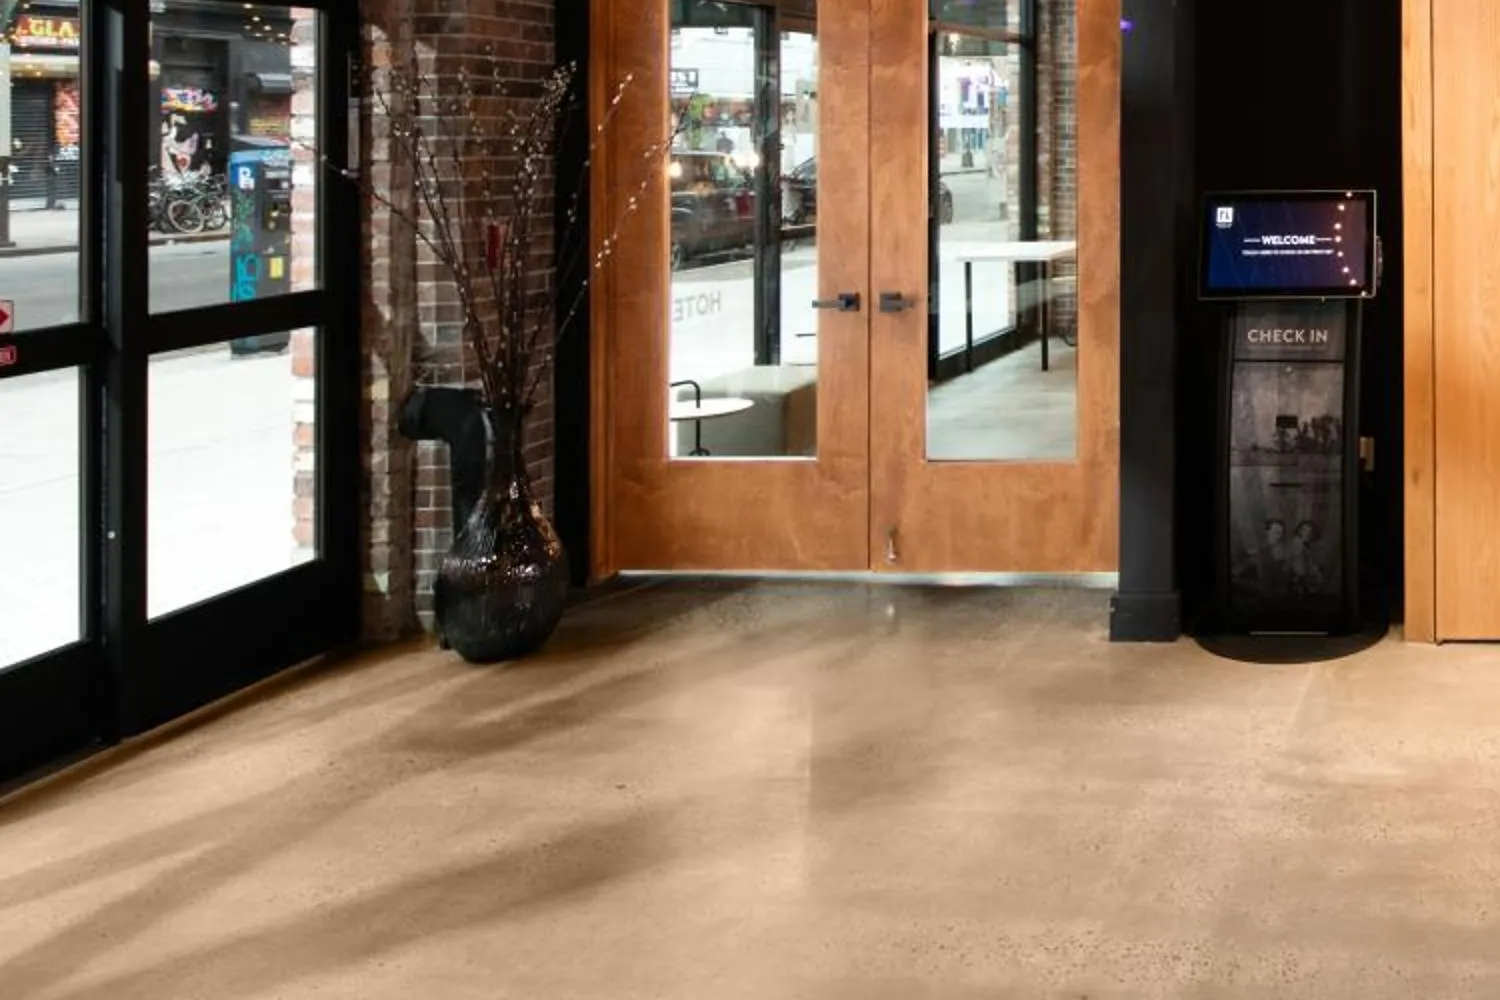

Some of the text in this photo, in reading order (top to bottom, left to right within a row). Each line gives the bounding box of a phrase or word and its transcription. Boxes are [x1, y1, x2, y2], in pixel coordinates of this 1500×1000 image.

[1261, 234, 1316, 246] WELCOME
[1247, 328, 1328, 344] CHECK IN
